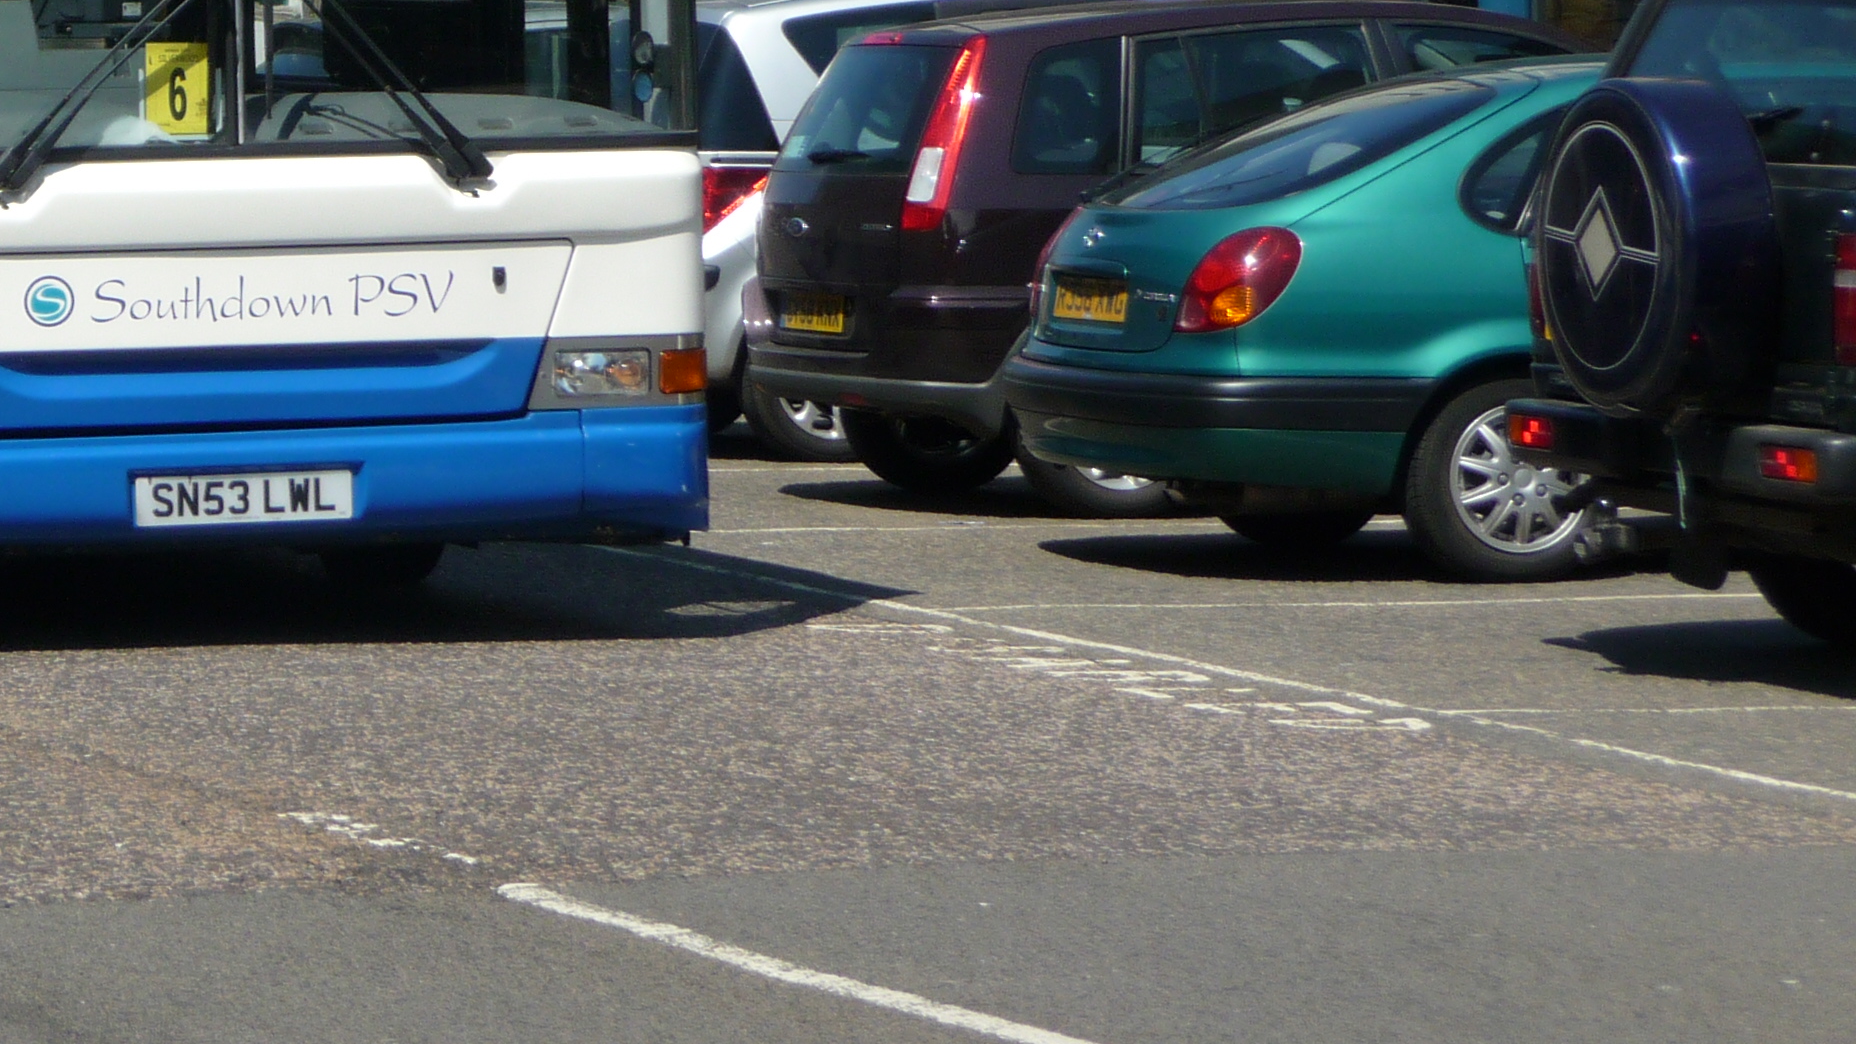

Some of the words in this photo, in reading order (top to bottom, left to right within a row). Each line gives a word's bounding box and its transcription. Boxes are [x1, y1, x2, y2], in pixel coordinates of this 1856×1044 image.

[169, 67, 187, 121] 6
[91, 276, 333, 322] Southdown
[348, 270, 454, 317] PSV
[152, 481, 250, 518] SN53
[264, 477, 336, 513] LWL
